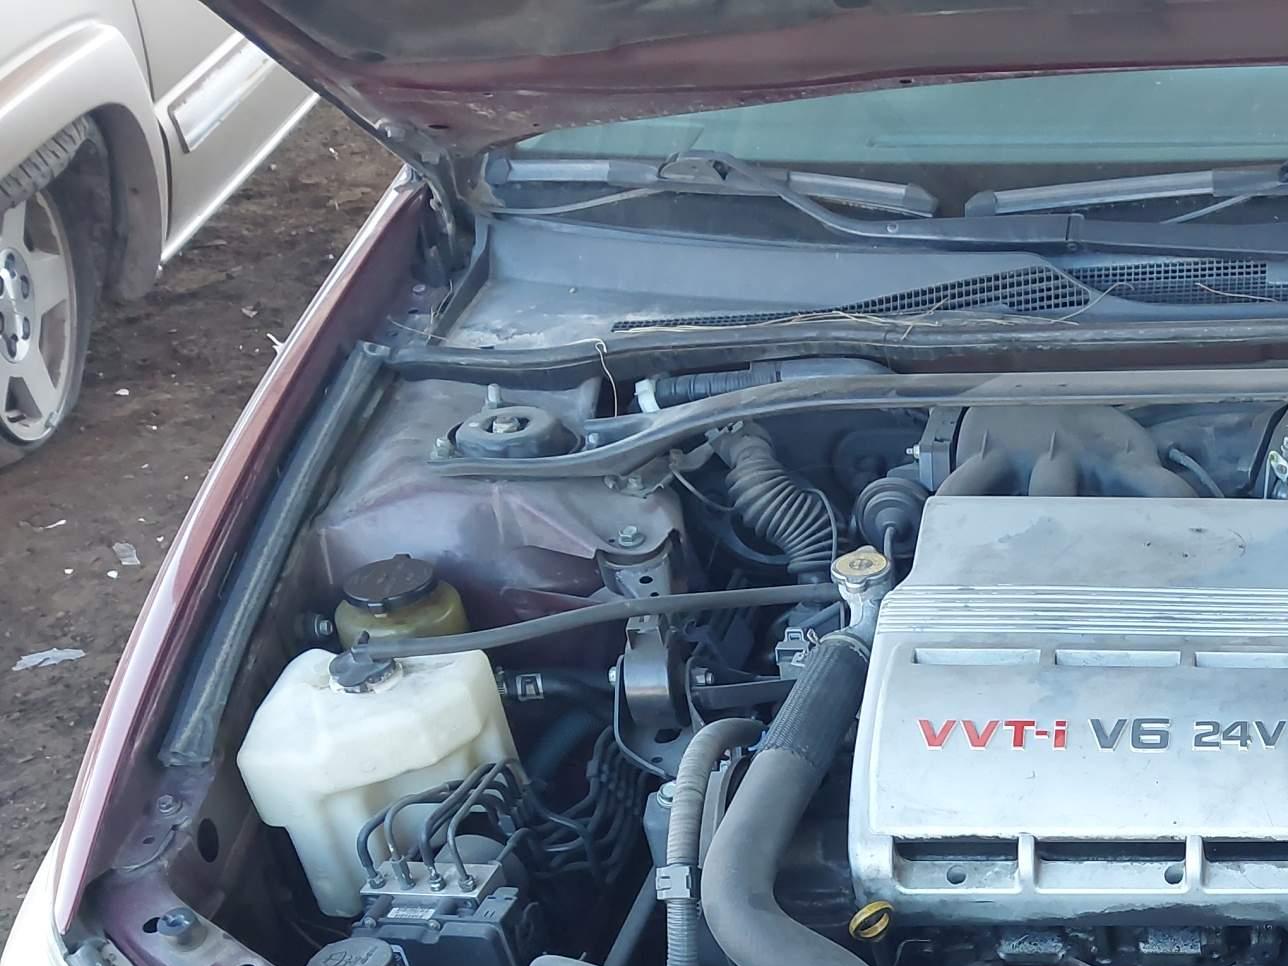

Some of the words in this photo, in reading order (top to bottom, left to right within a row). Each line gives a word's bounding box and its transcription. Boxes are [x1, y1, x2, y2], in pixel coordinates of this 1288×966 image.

[918, 719, 1069, 750] VVT-i
[1088, 718, 1171, 751] V6
[1192, 720, 1287, 750] 24V
